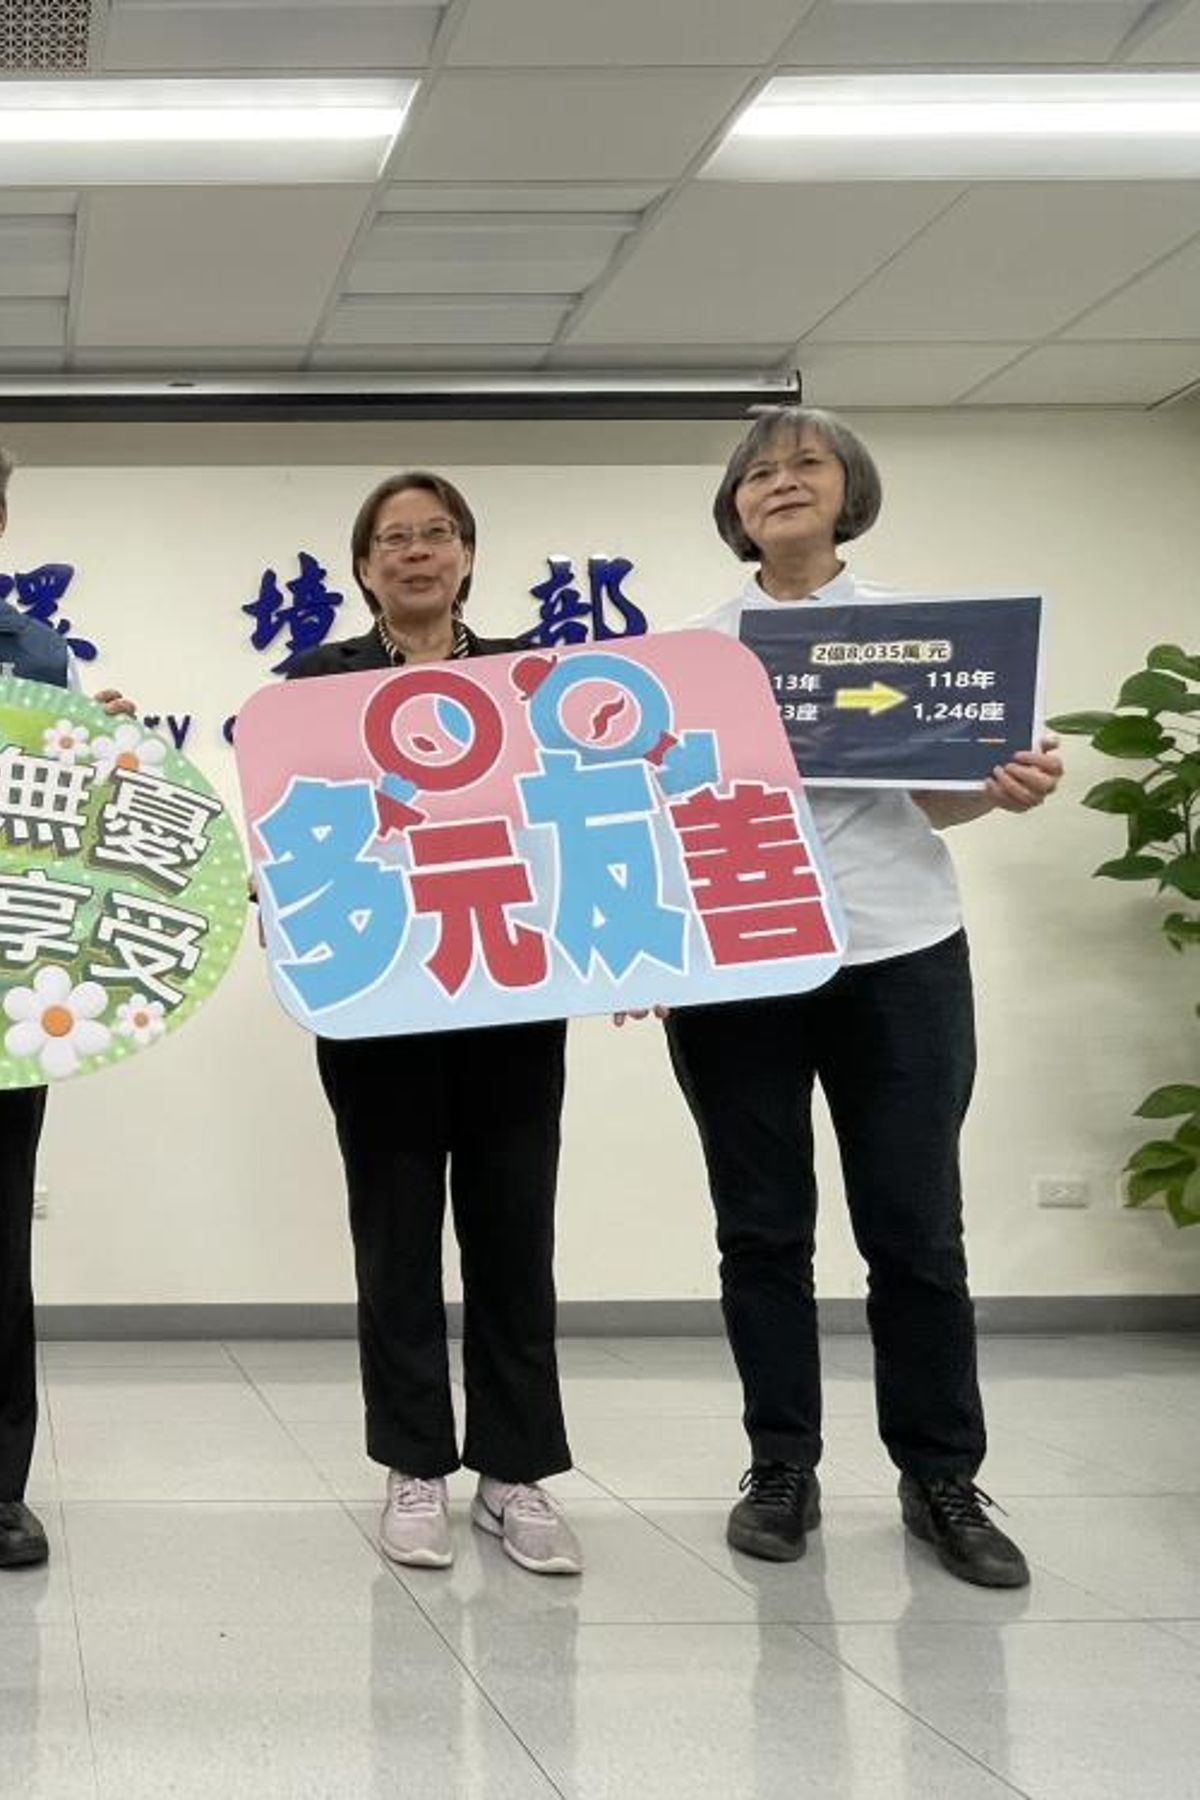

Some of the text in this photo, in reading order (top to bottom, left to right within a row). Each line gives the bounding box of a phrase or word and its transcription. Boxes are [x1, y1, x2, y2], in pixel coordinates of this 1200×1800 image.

[772, 673, 821, 692] 13年
[926, 669, 996, 690] 118年
[913, 701, 1005, 723] 1,246座
[253, 749, 840, 1014] 多元友善
